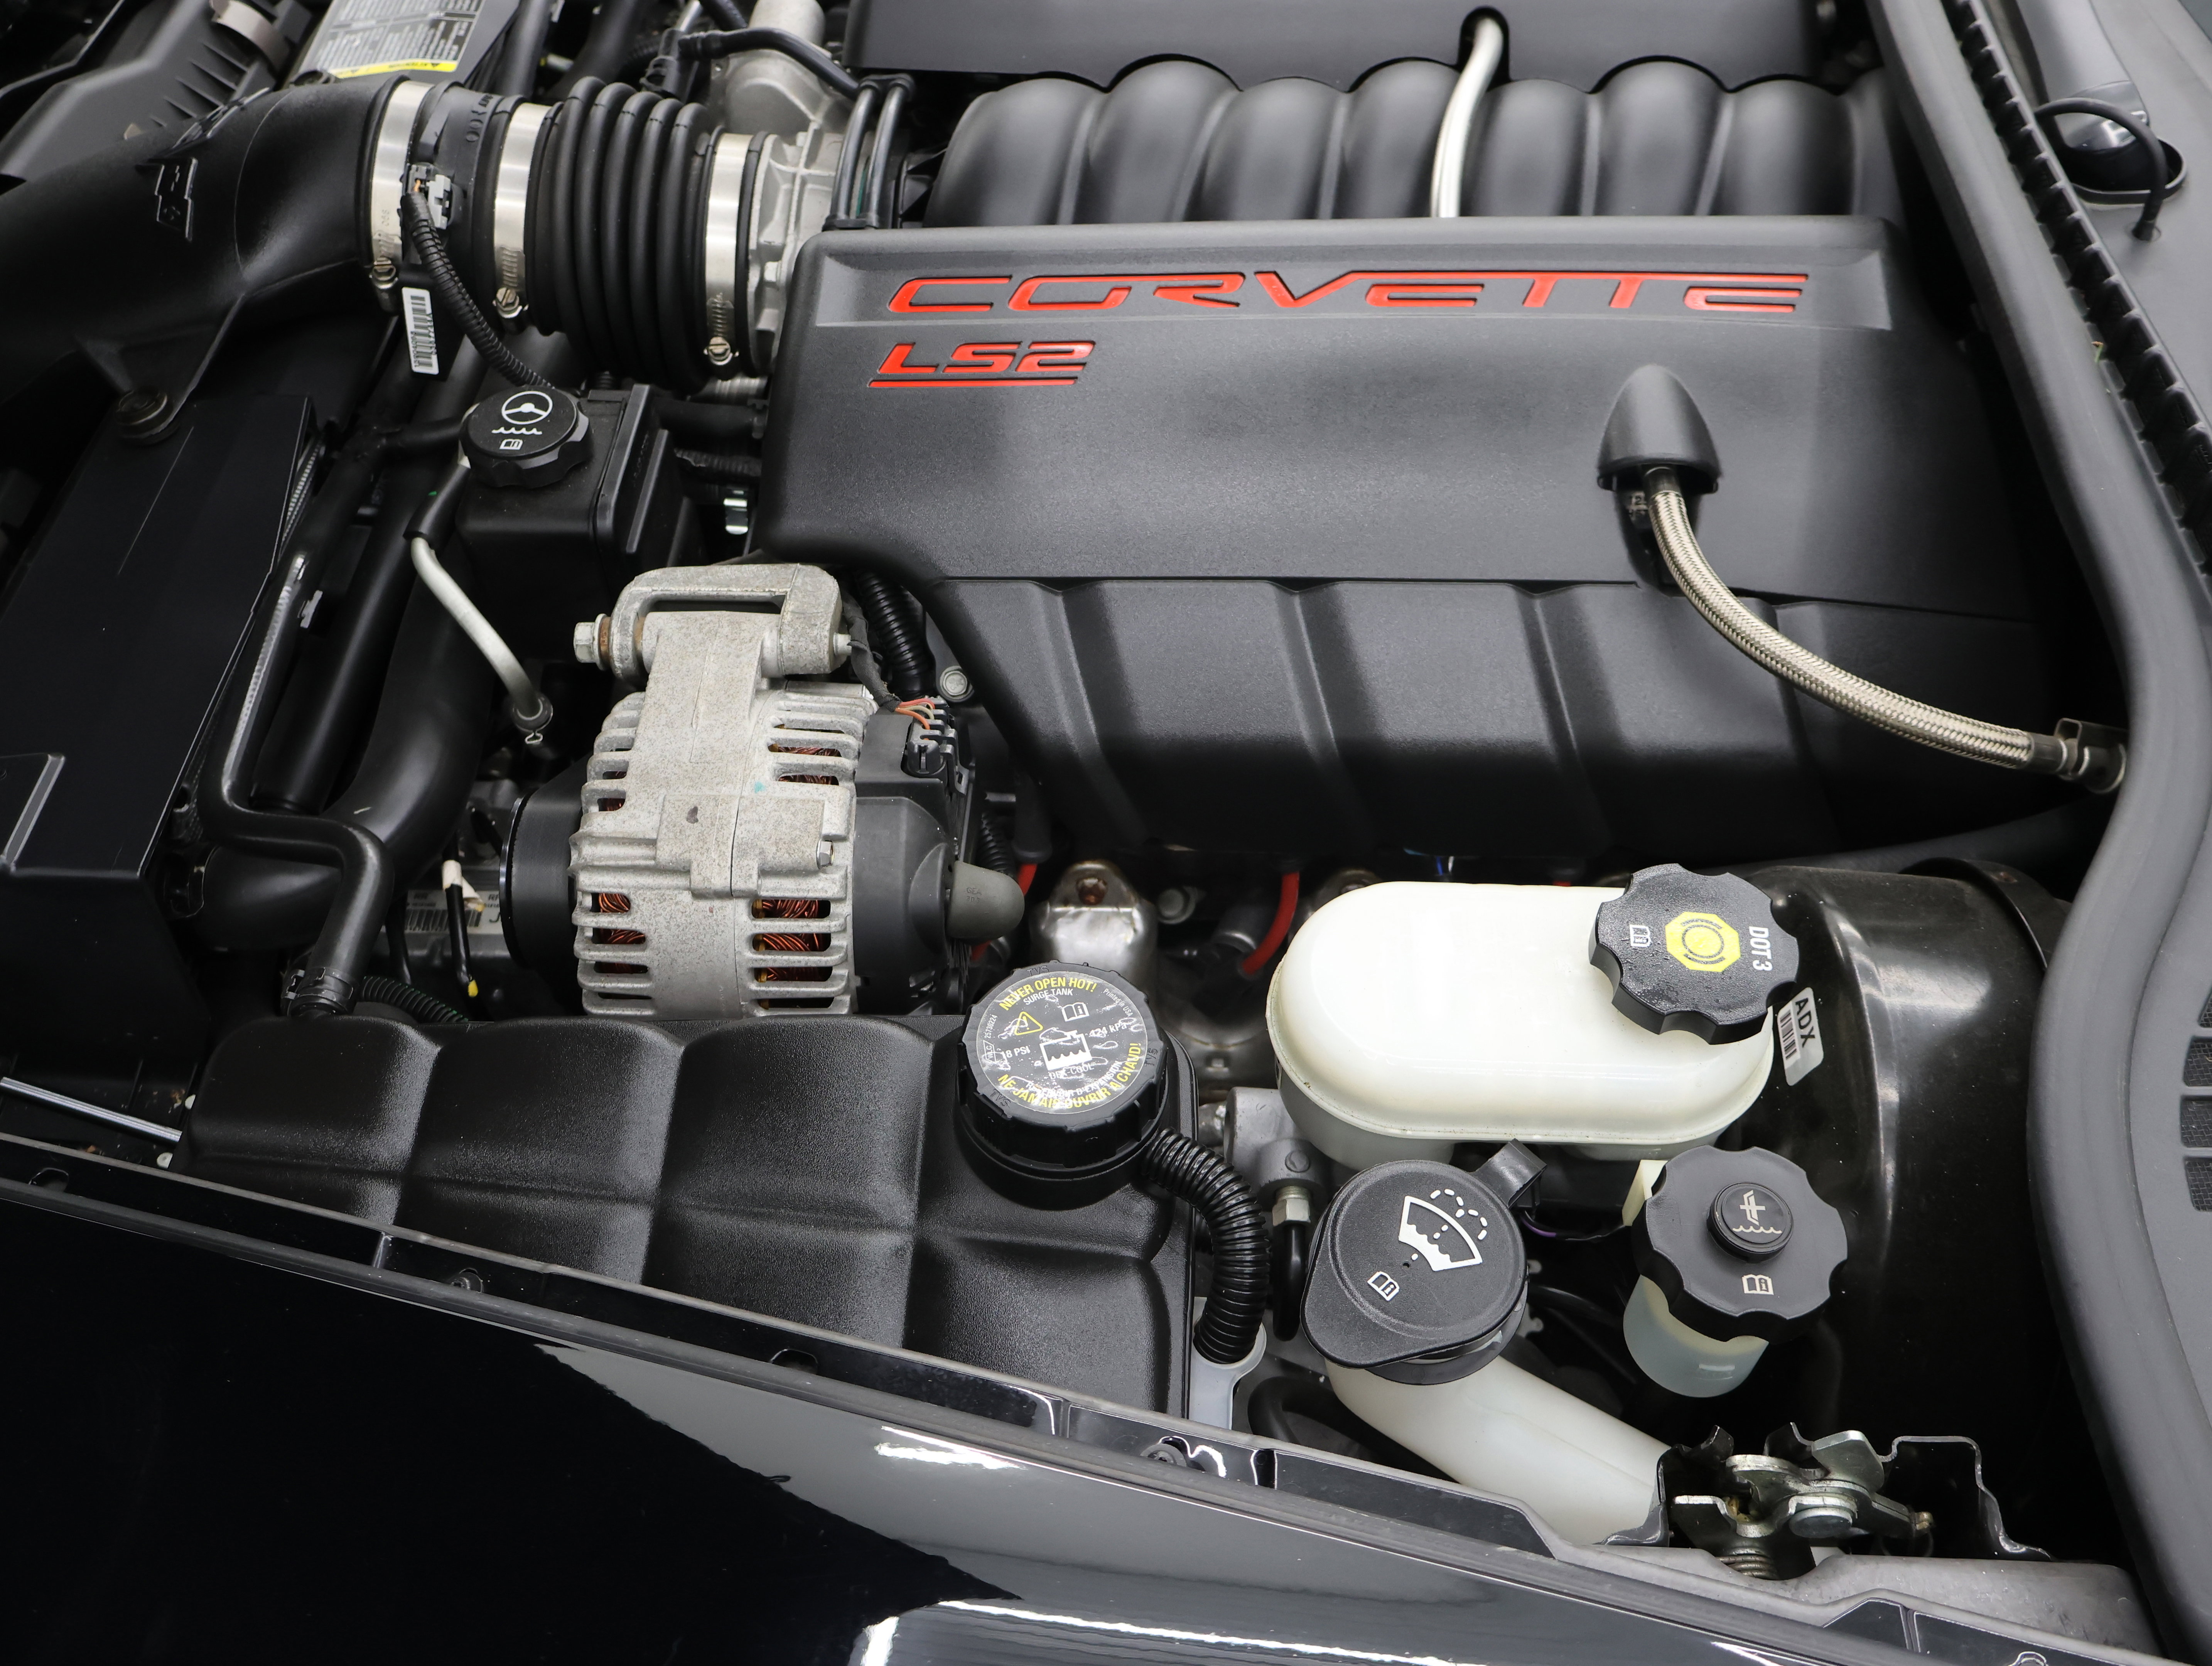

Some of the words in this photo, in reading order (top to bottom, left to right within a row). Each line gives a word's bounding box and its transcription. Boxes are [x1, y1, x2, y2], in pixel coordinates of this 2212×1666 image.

[888, 271, 1808, 314] CORVETTE
[878, 342, 1095, 374] LS2
[1749, 926, 1772, 959] DOT
[1027, 965, 1049, 976] TVS
[1752, 959, 1773, 971] 3
[999, 984, 1034, 1011] NEVER
[1034, 977, 1066, 990] OPEN
[1069, 977, 1097, 992] HOT!
[1023, 990, 1049, 1005] SURGE
[1103, 988, 1121, 1003] Printed
[1123, 1006, 1133, 1017] USA
[984, 1014, 998, 1039] 25730224
[1109, 1022, 1127, 1033] kPa
[1795, 997, 1815, 1048] ADX
[1014, 1045, 1030, 1056] PSI
[1144, 1048, 1158, 1066] TVS
[997, 1074, 1016, 1088] NE
[1117, 1043, 1141, 1082] CHAUD!
[990, 1089, 1011, 1106] TVS
